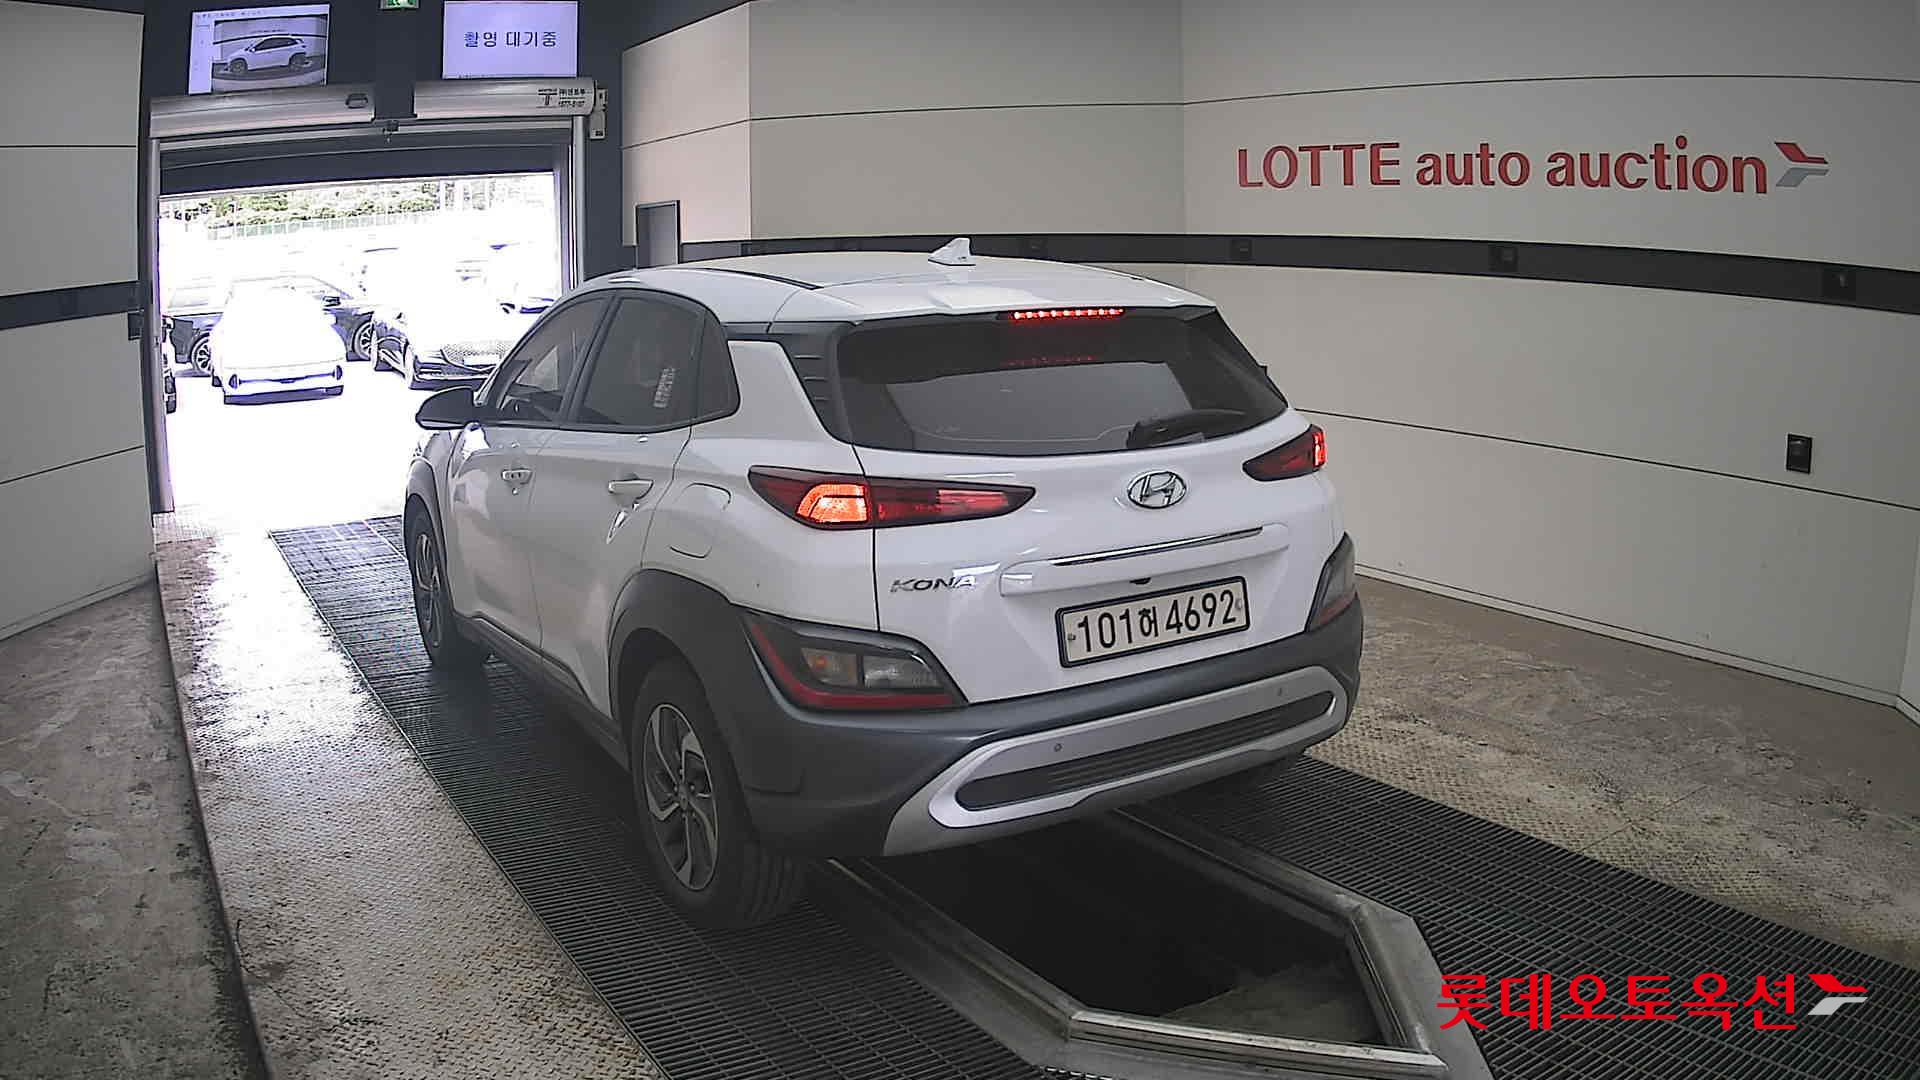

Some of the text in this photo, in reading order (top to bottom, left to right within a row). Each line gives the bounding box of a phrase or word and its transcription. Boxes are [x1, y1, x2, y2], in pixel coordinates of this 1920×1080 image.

[464, 31, 556, 48] 촬영 대기중
[1236, 136, 1768, 194] LOTTE auto auction
[890, 574, 977, 593] KONA
